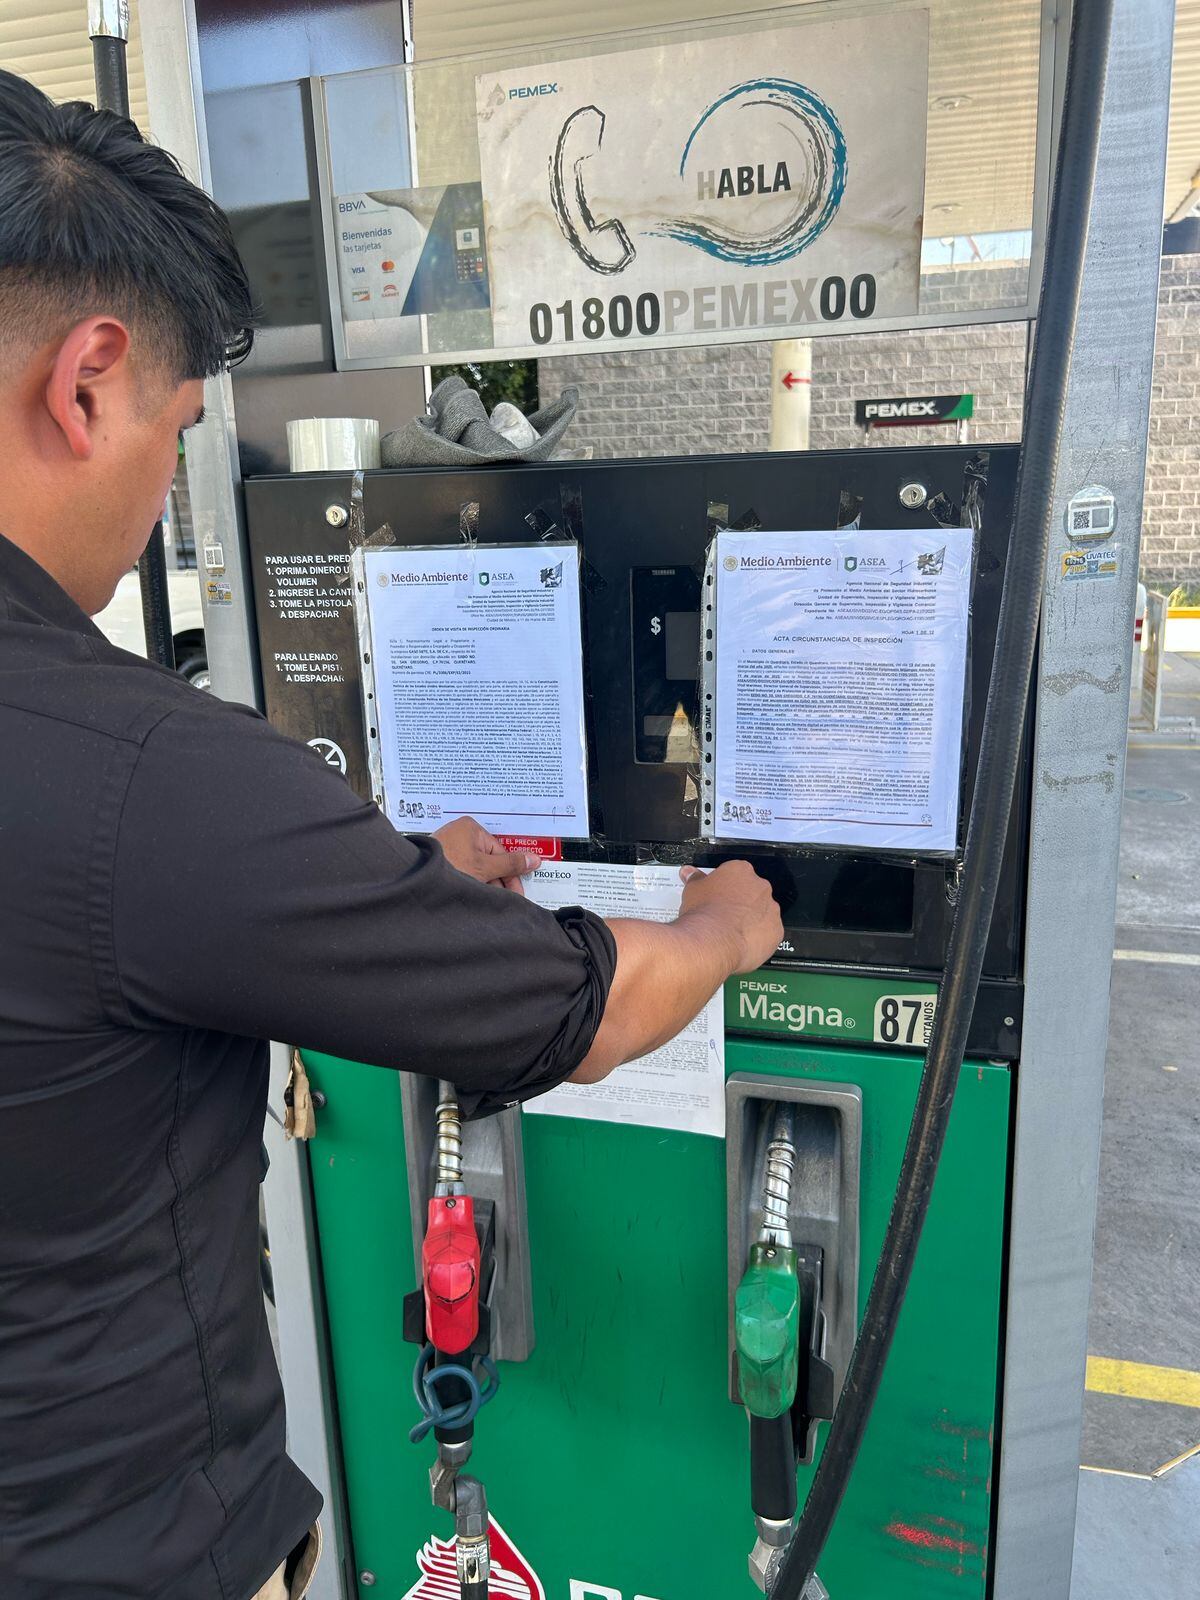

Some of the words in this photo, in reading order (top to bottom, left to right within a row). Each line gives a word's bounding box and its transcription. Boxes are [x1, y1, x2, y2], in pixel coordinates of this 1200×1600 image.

[509, 83, 558, 99] PEMEX
[697, 161, 792, 201] HABLA
[339, 200, 366, 213] BBVA
[342, 227, 392, 241] Bienvenidas
[343, 245, 353, 253] las
[354, 242, 382, 252] tarjetas
[351, 266, 365, 274] VISA
[865, 400, 936, 418] PEMEX
[265, 556, 289, 565] PARA
[290, 555, 314, 564] USAR
[315, 555, 327, 564] EL
[328, 554, 352, 563] PRED
[740, 557, 774, 567] Medio
[776, 556, 832, 566] Ambiente
[859, 557, 886, 566] ASEA
[266, 567, 274, 576] 1.
[275, 567, 308, 575] OPRIMA
[309, 566, 342, 575] DINERO
[276, 577, 318, 586] VOLUMEN
[391, 572, 420, 583] Medio
[421, 572, 468, 582] Ambiente
[491, 572, 514, 581] ASEA
[269, 589, 277, 598] 2.
[278, 589, 314, 597] INGRESE
[316, 588, 327, 596] LA
[269, 600, 278, 608] 3.
[278, 600, 303, 608] TOME
[304, 600, 315, 608] LA
[317, 599, 353, 607] PISTOLA
[280, 611, 287, 619] A
[288, 610, 340, 619] DESPACHAR
[864, 636, 903, 644] INSPECCIÓN
[274, 653, 298, 661] PARA
[299, 653, 339, 661] LLENADO
[275, 664, 283, 672] 1.
[284, 664, 308, 672] TOME
[309, 664, 321, 672] LA
[322, 664, 343, 672] PIST
[294, 674, 345, 682] DESPACHAR
[739, 980, 788, 993] PEMEX
[880, 998, 922, 1044] 87
[923, 1001, 934, 1044] OCTANOS
